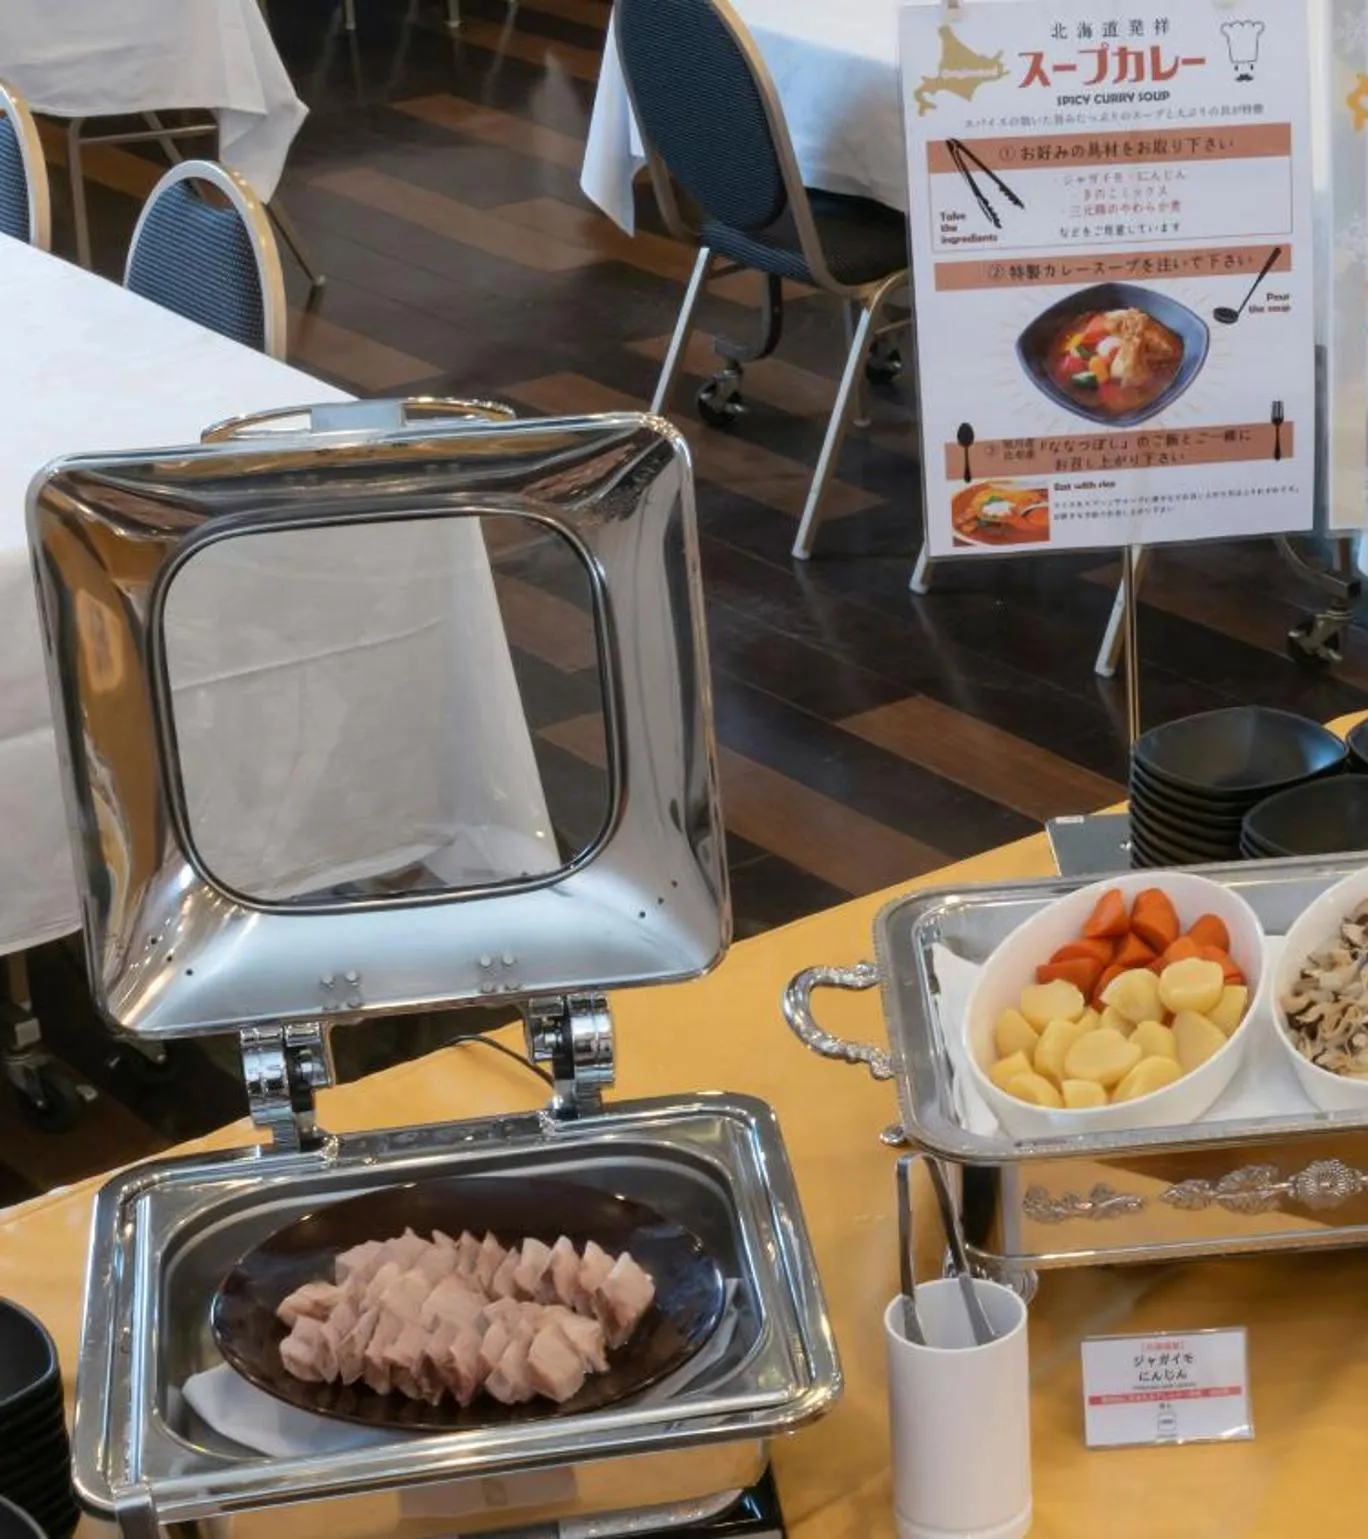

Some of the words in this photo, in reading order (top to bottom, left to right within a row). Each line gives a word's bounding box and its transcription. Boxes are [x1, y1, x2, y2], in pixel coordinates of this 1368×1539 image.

[1051, 17, 1170, 40] 北海道発祥
[1017, 41, 1206, 89] スープカレー
[1056, 94, 1091, 107] SPICY
[1094, 92, 1135, 105] CURRY
[1138, 90, 1171, 102] SOUP
[1132, 1352, 1195, 1368] ジャガイモ
[1138, 1368, 1188, 1382] にんじん
